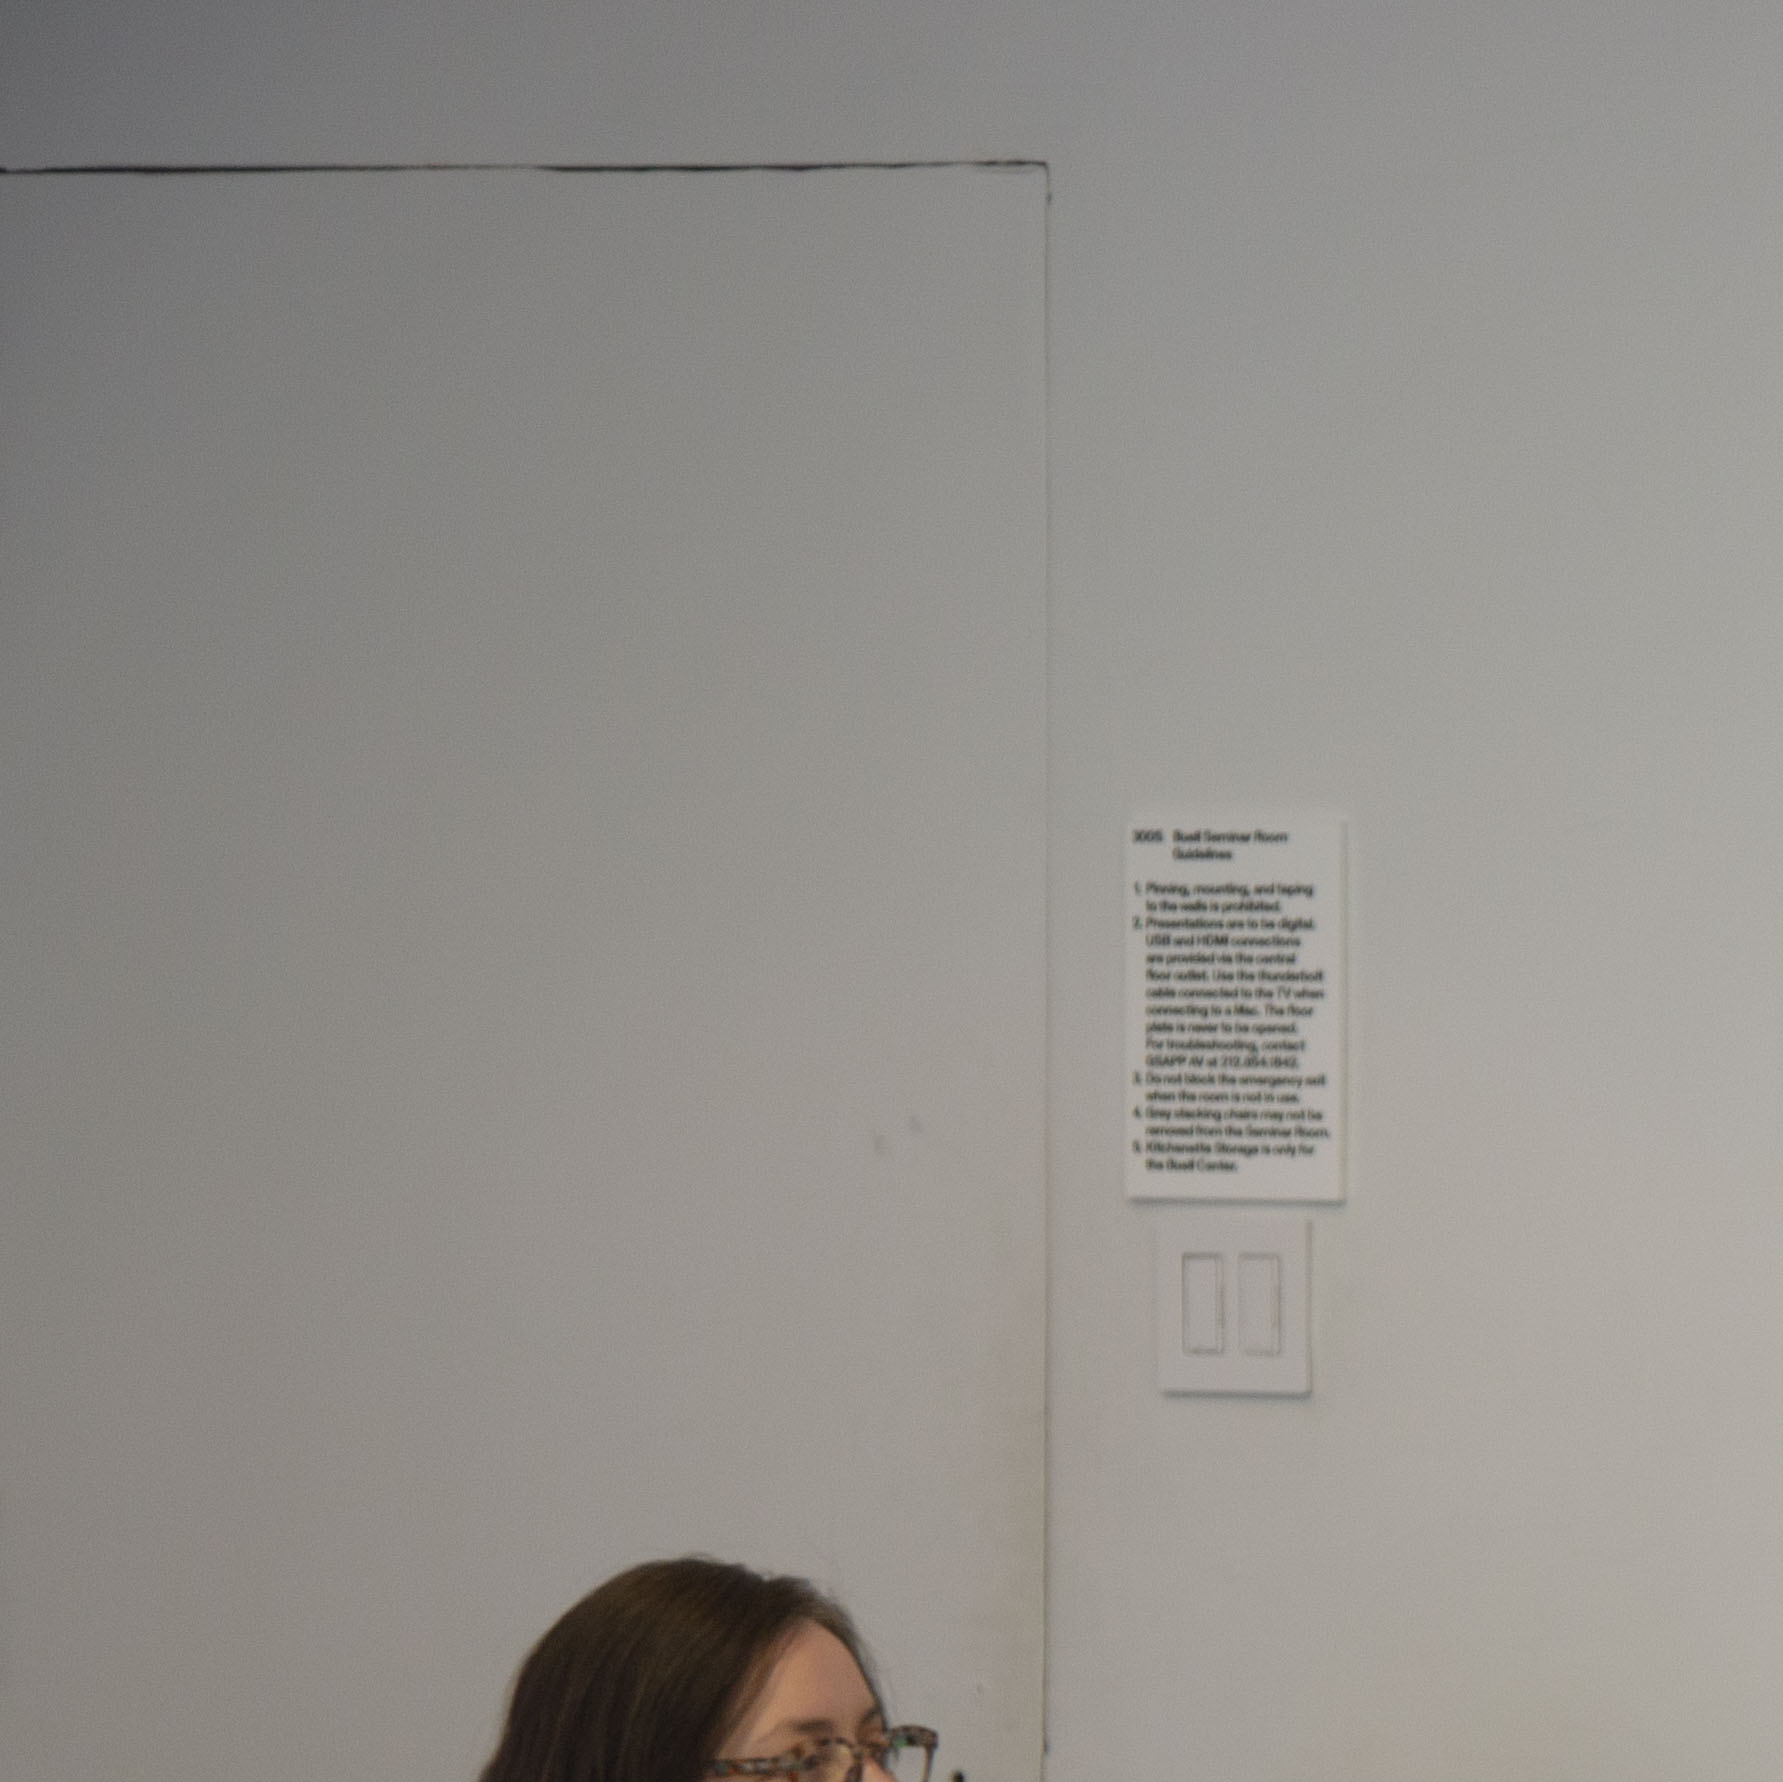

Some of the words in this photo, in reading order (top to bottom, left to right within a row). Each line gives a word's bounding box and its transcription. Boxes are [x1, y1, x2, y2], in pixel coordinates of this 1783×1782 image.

[1173, 830, 1200, 842] Buell
[1204, 830, 1250, 842] Seminar
[1254, 830, 1288, 842] Room
[1173, 848, 1232, 861] Guidelines
[1278, 883, 1314, 897] taping
[1181, 901, 1207, 913] walls
[1146, 918, 1223, 929] Presentations
[1146, 935, 1170, 947] USB
[1173, 935, 1194, 947] and
[1197, 935, 1229, 947] HDMI
[1231, 935, 1301, 947] connections
[1166, 952, 1214, 966] provided
[1256, 952, 1295, 964] central
[1146, 969, 1170, 981] floor
[1213, 969, 1234, 981] Use
[1258, 970, 1323, 982] thunderbolt
[1146, 987, 1175, 998] cable
[1178, 987, 1238, 998] connected
[1294, 988, 1324, 999] when
[1146, 1004, 1207, 1018] connecting
[1287, 1005, 1313, 1017] floor
[1146, 1022, 1173, 1036] plate
[1188, 1024, 1217, 1034] never
[1262, 1040, 1305, 1052] contact
[1146, 1055, 1186, 1067] GSAPP
[1185, 1073, 1215, 1085] block
[1239, 1076, 1303, 1088] emergency
[1146, 1090, 1175, 1102] when
[1199, 1092, 1228, 1102] room
[1174, 1108, 1221, 1121] stacking
[1224, 1109, 1257, 1120] chairs
[1261, 1111, 1283, 1122] may
[1146, 1126, 1193, 1137] removed
[1196, 1126, 1222, 1137] from
[1246, 1127, 1291, 1138] Seminar
[1146, 1142, 1211, 1154] Kitchenette
[1214, 1143, 1258, 1157] Storage
[1272, 1143, 1295, 1157] only
[1166, 1159, 1193, 1172] Buell
